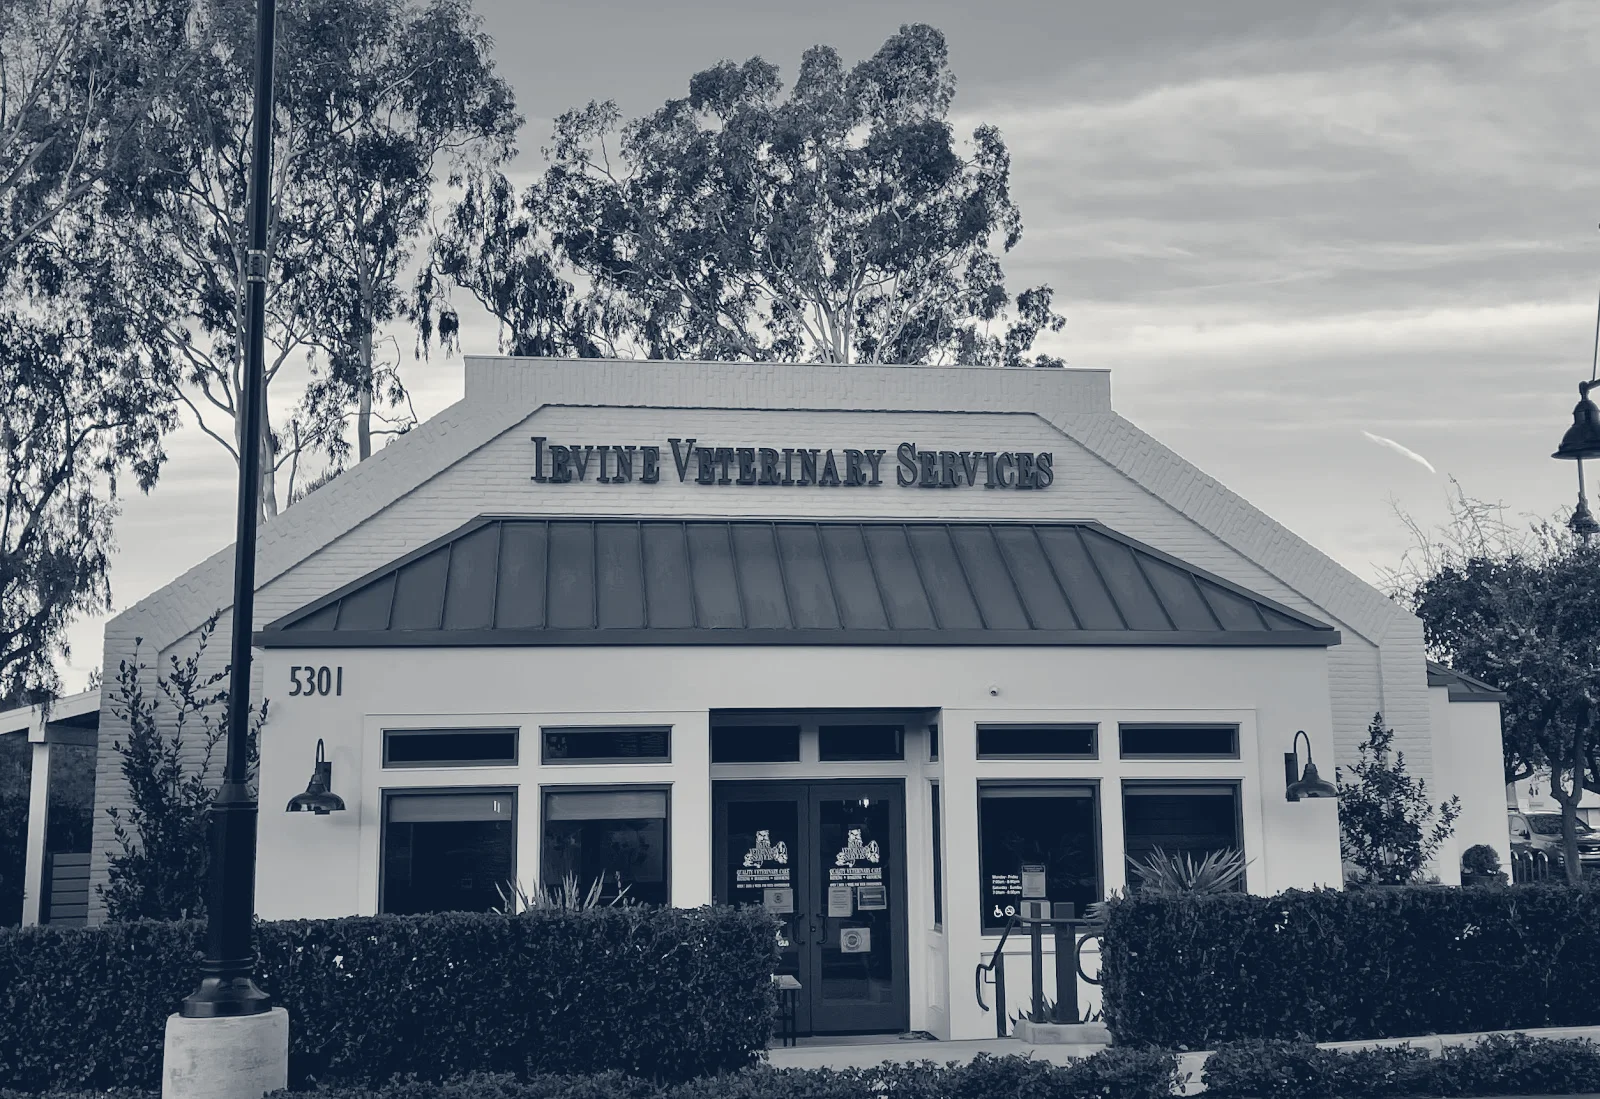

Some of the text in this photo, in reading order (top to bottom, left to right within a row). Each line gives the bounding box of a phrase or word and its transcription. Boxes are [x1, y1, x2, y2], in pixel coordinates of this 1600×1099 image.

[531, 437, 1054, 489] IRVINE VETERINARY SERVICES
[289, 666, 343, 696] 5301
